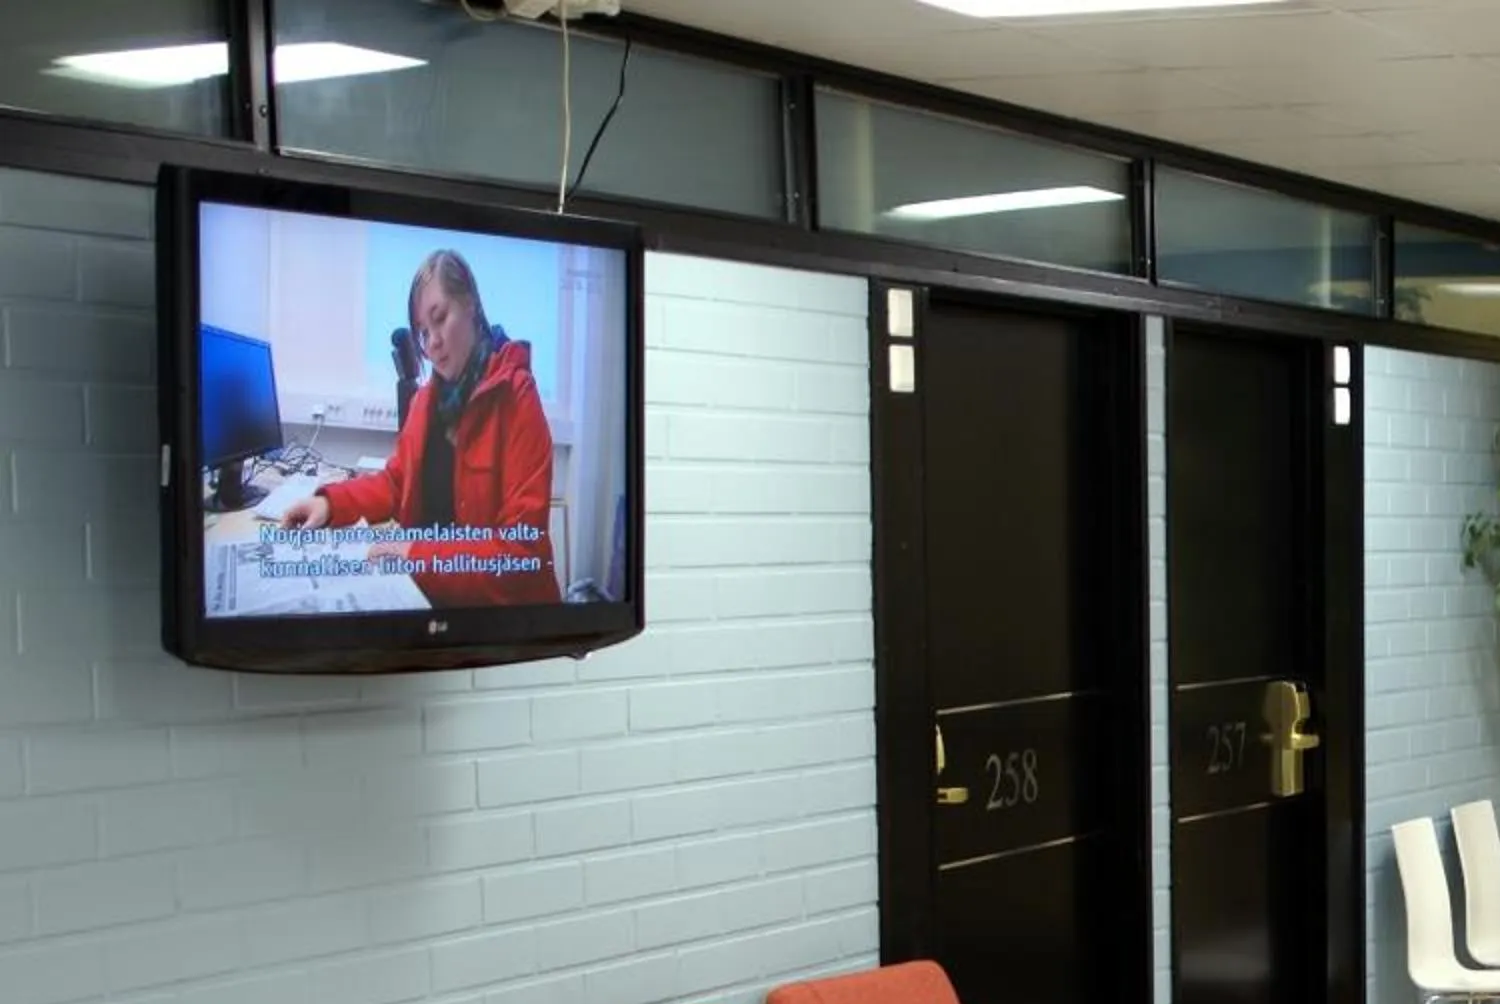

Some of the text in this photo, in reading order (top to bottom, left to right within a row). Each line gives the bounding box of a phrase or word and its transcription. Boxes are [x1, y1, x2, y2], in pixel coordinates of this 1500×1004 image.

[259, 521, 545, 550] Norjan porosaamelaisten valta-
[259, 554, 371, 577] kunnallisen
[432, 553, 541, 576] hallitusjäsen
[1207, 721, 1247, 774] 257
[985, 748, 1039, 810] 258
